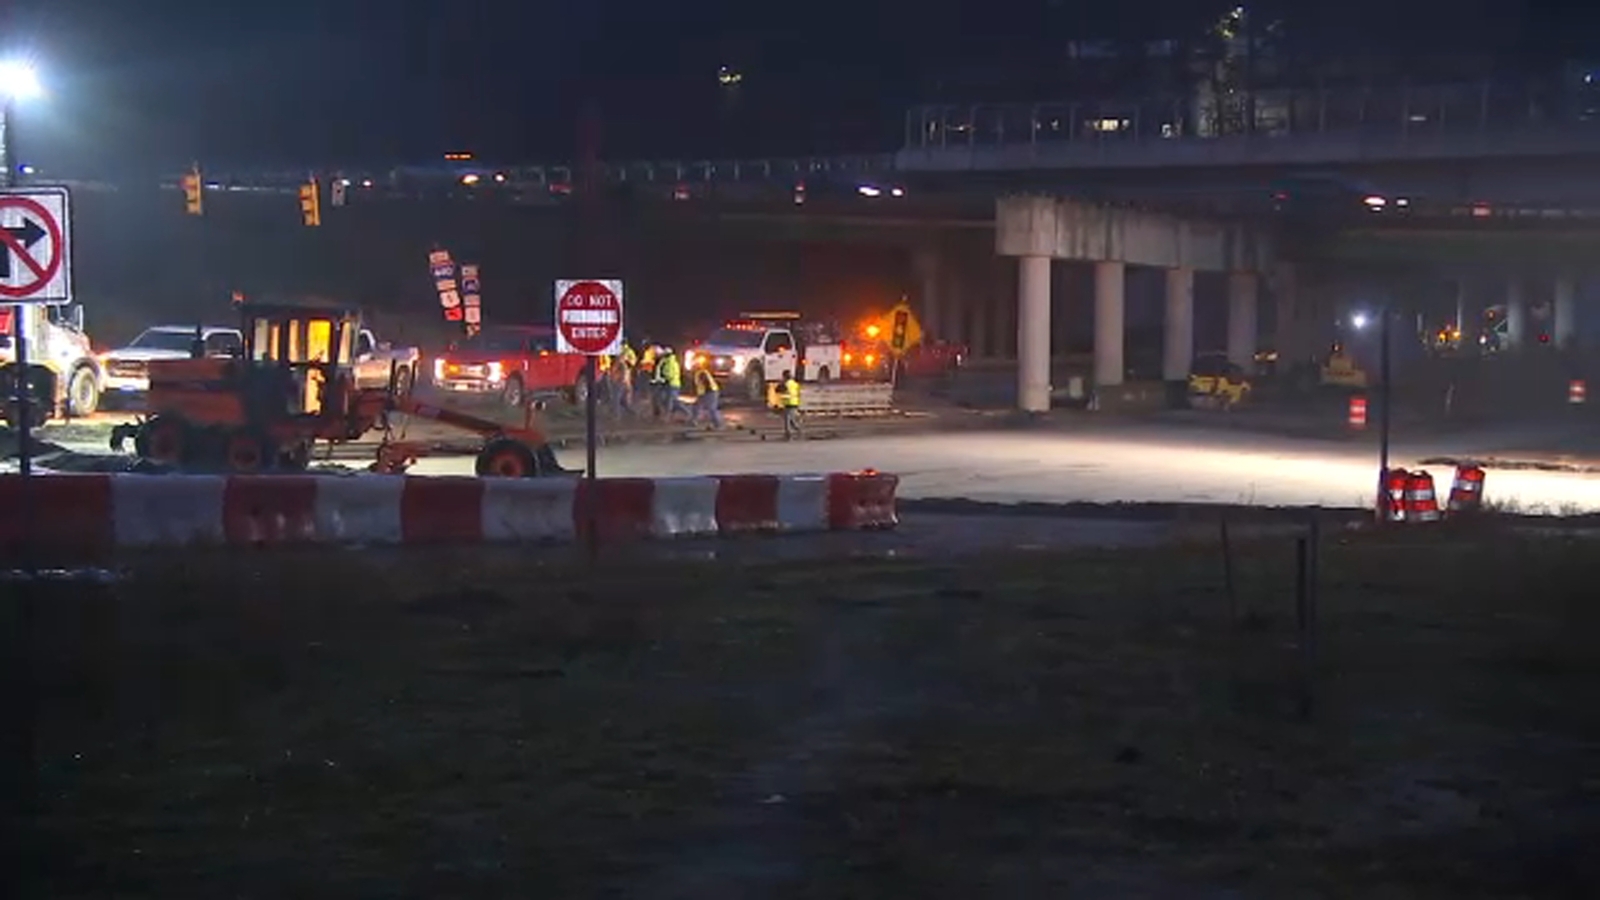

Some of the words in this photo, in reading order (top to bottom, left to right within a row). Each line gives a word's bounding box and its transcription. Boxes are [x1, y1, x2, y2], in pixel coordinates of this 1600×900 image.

[566, 294, 583, 307] DO
[589, 294, 612, 307] NOT
[571, 327, 608, 339] ENTER
